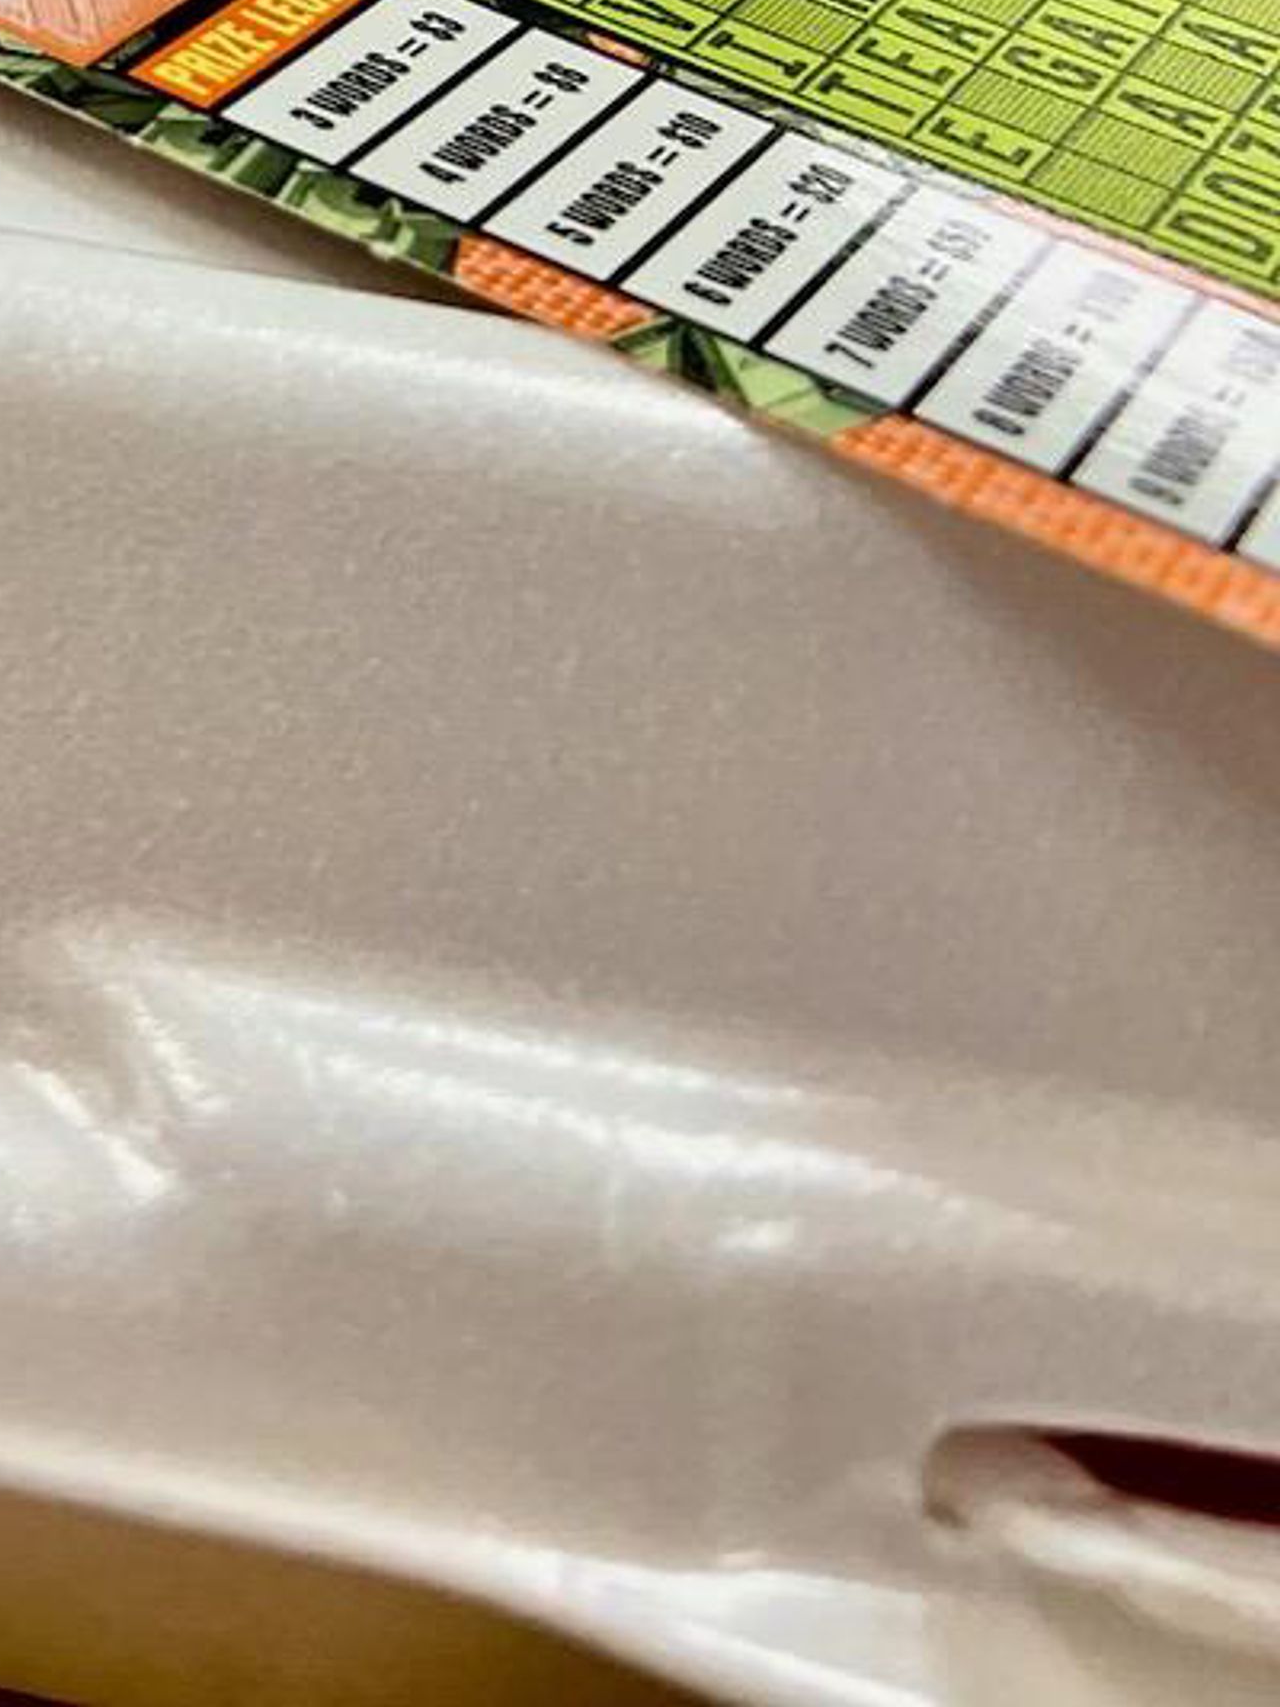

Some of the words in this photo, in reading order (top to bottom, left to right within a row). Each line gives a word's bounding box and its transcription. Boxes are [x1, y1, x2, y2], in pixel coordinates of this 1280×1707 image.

[150, 18, 271, 97] PRIZE
[289, 105, 336, 131] 3
[313, 50, 403, 118] WORDS
[407, 9, 468, 43] $3
[816, 4, 1000, 122] TEA
[439, 103, 538, 173] WORDS
[656, 109, 725, 152] $10
[931, 117, 1032, 170] E
[418, 158, 468, 186] 4
[561, 159, 667, 232] WORDS
[545, 220, 596, 247] 5
[695, 216, 801, 295] WORDS
[787, 160, 857, 208] $20
[839, 275, 937, 354] WORDS
[824, 341, 875, 371] 7
